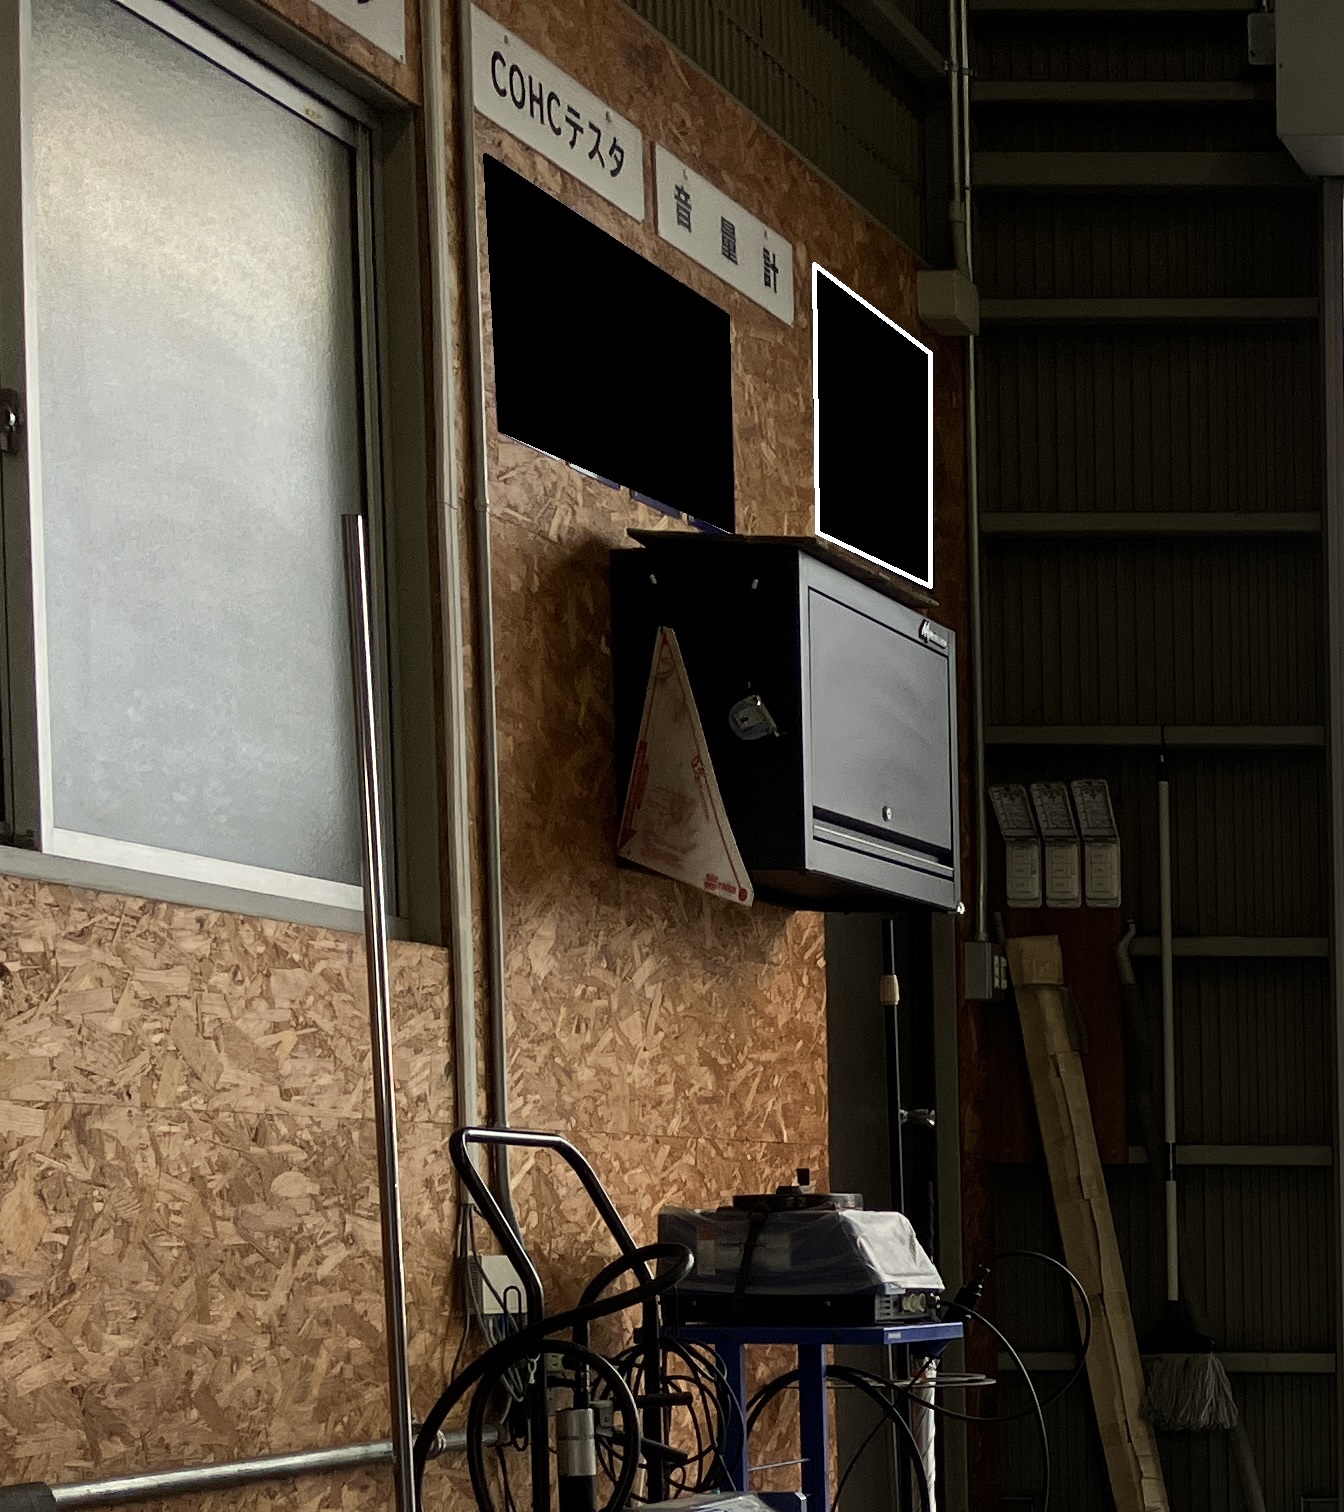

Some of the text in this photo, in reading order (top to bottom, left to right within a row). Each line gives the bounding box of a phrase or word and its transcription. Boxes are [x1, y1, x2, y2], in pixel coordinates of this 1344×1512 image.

[491, 51, 625, 178] COHCテスタ
[674, 184, 781, 294] 音量計
